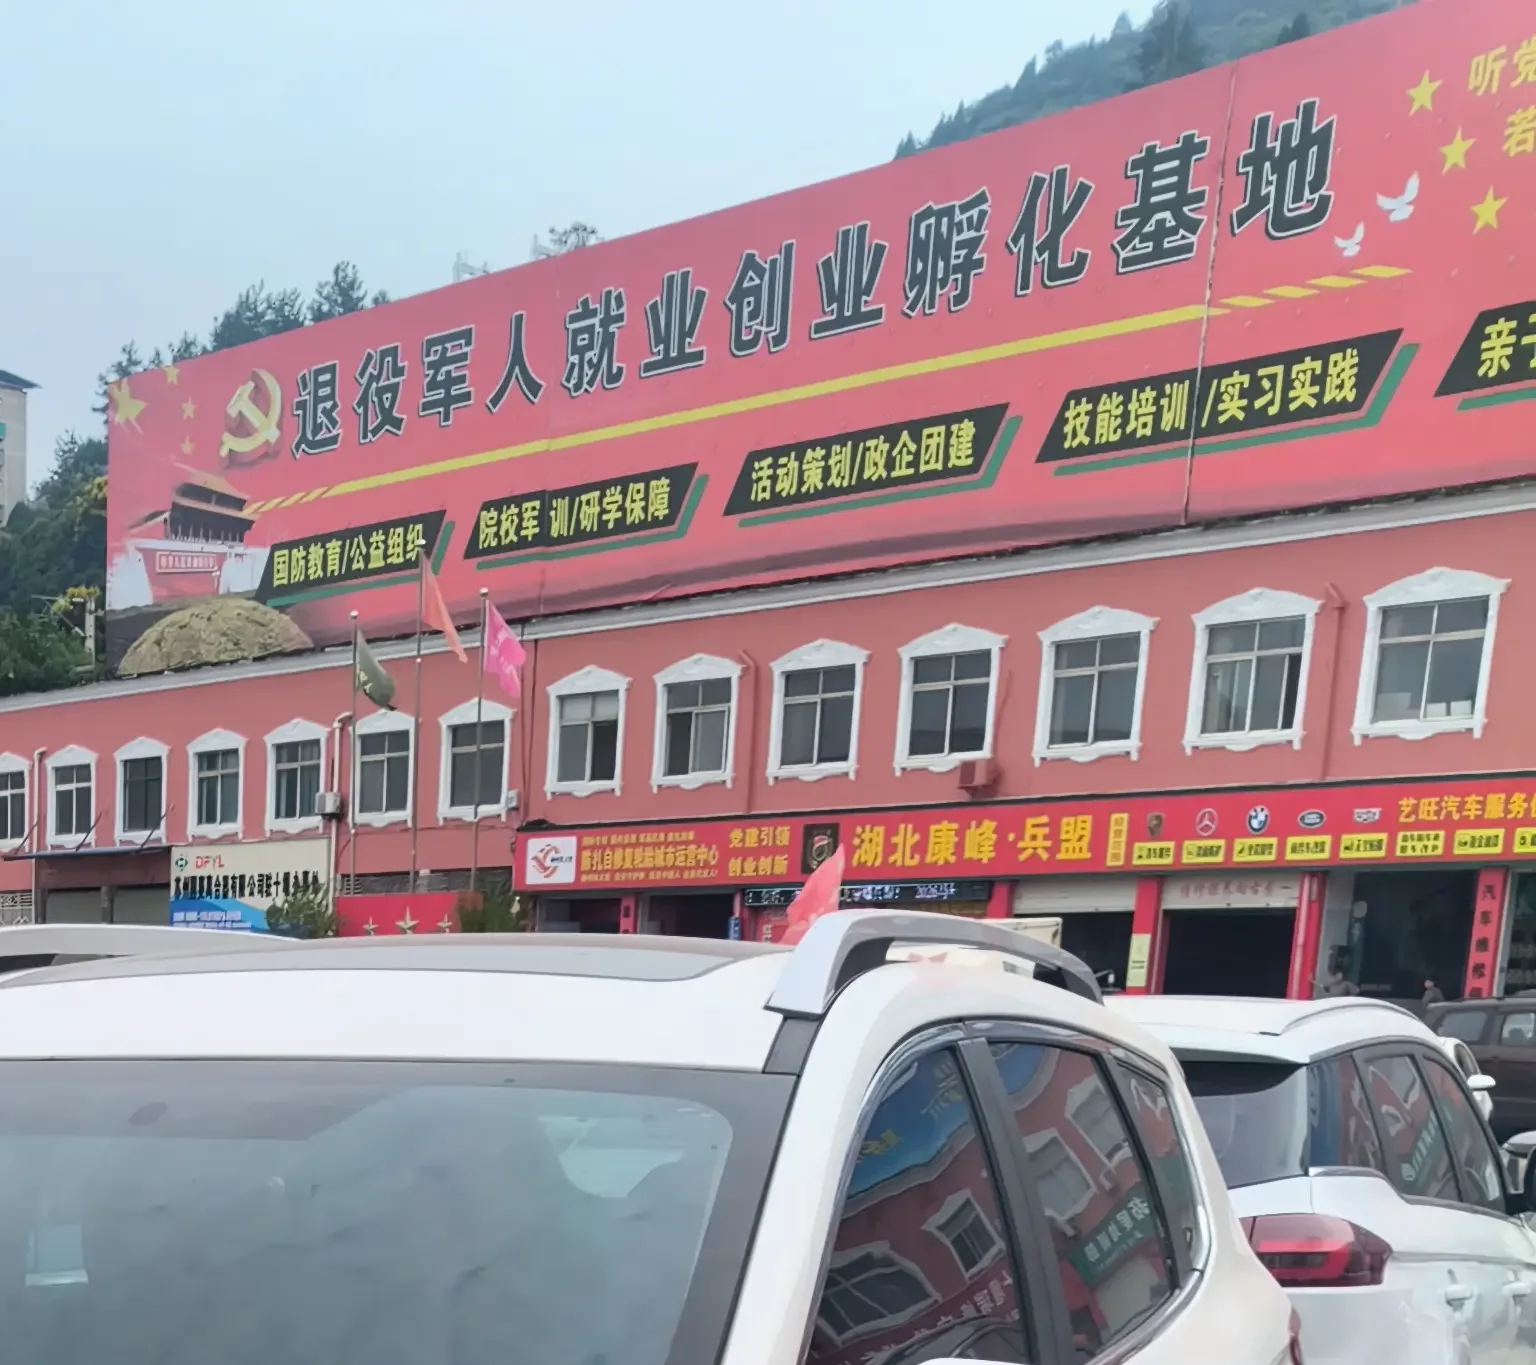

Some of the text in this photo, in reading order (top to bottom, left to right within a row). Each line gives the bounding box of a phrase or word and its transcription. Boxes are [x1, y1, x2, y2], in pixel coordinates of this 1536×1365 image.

[291, 97, 1337, 459] 退役军人就业创业孵化基地
[1064, 347, 1359, 450] 技能培训/实习实践
[750, 419, 976, 503] 活动策划/政企团建
[478, 477, 671, 549] 院校军训/研学保障
[272, 524, 425, 587] 国防教育/公益组织
[728, 854, 789, 877] 创业创新
[729, 826, 791, 848] 党建引领
